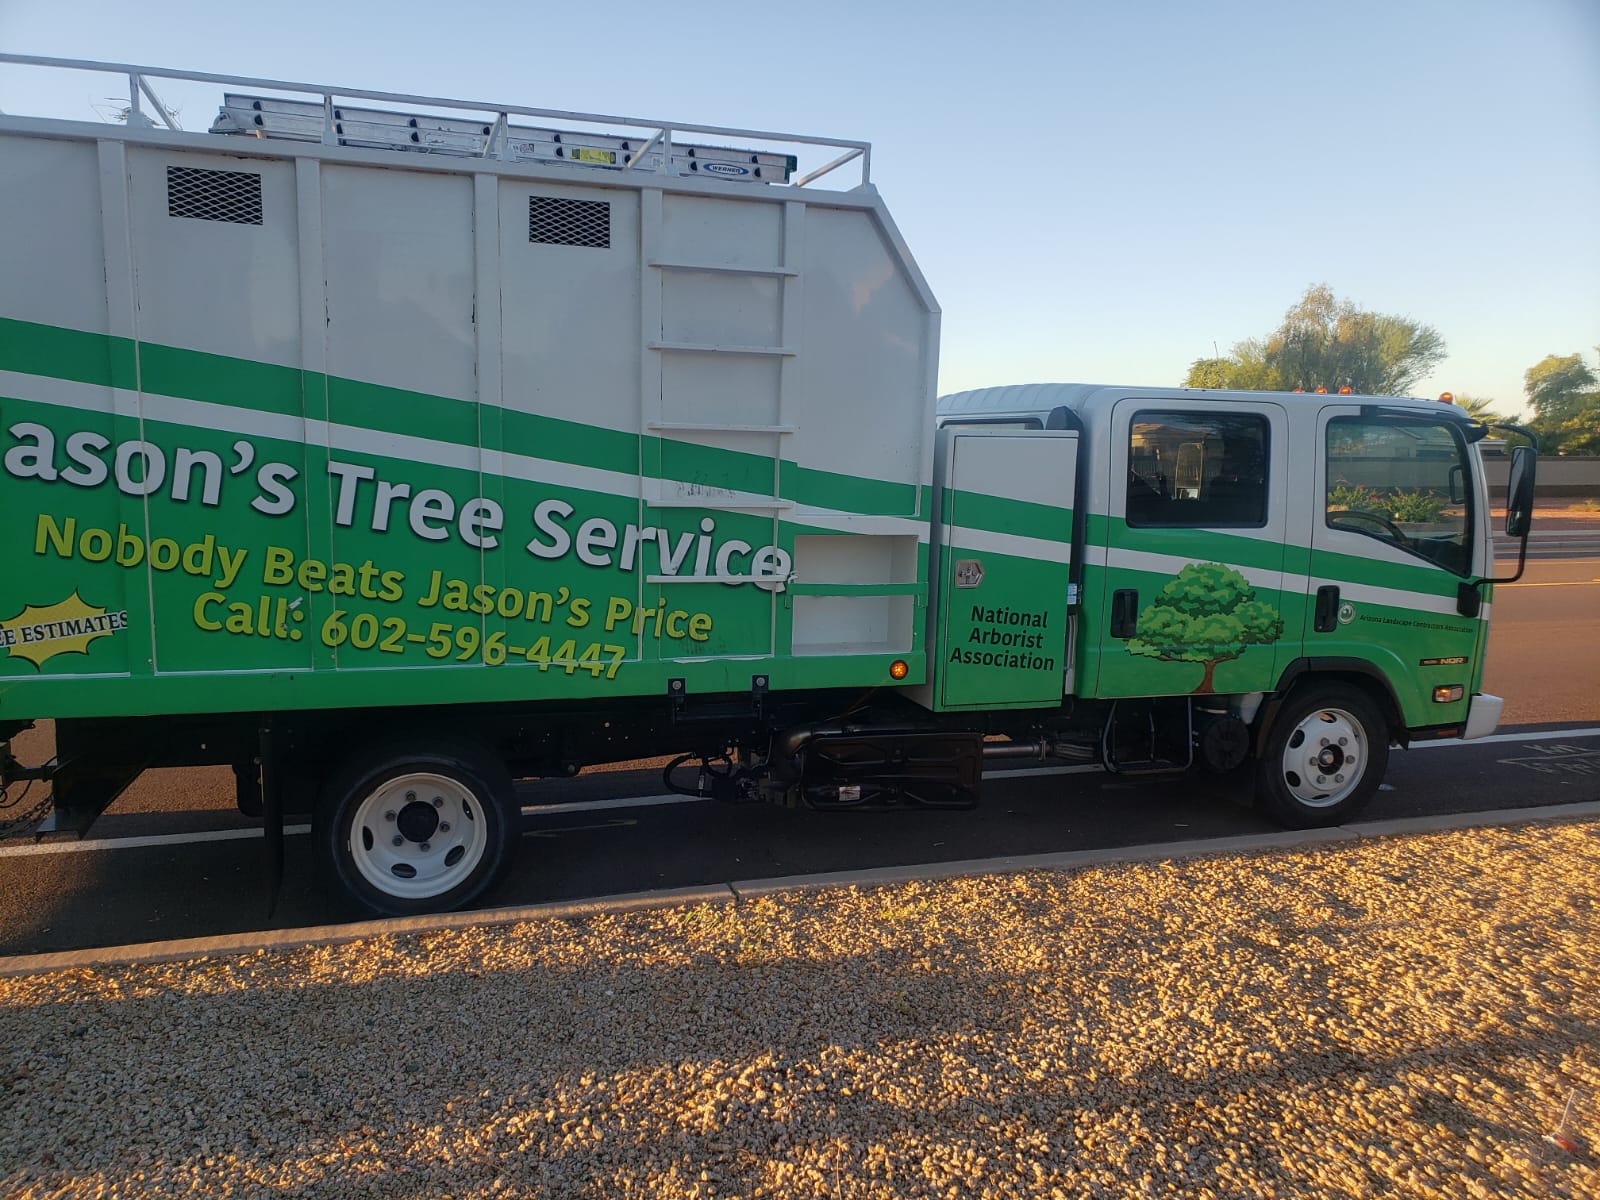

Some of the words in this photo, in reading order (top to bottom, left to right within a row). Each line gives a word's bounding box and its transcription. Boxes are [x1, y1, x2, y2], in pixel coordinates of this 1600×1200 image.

[328, 460, 504, 550] Tree
[526, 499, 792, 593] Service
[34, 514, 248, 588] Nobody
[263, 546, 405, 601] Beats
[418, 570, 591, 628] Jason's
[605, 597, 712, 641] Price
[21, 612, 128, 643] ESTIMATES
[971, 605, 1048, 628] National
[193, 593, 304, 641] Call:
[321, 611, 626, 679] 602-596-4447
[968, 627, 1043, 649] Arborist
[949, 647, 1054, 671] Association
